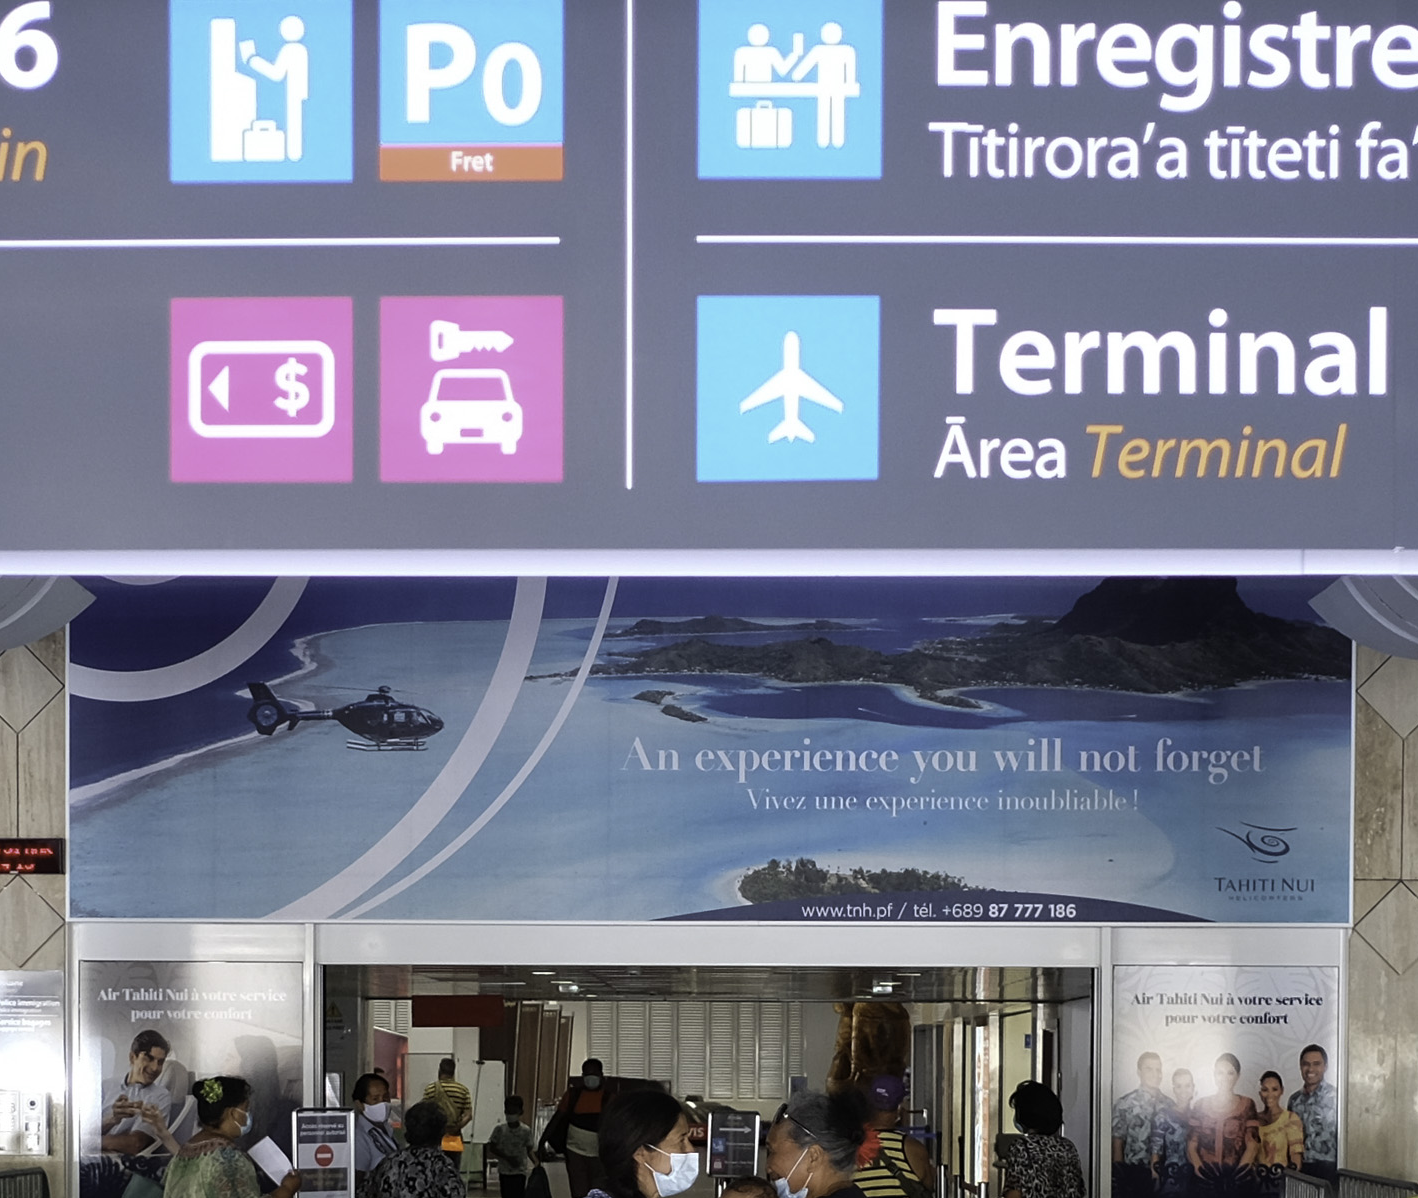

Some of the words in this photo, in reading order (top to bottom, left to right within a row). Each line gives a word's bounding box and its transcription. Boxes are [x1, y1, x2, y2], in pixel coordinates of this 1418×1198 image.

[449, 151, 495, 173] Fret
[933, 306, 1388, 397] Terminal
[933, 416, 1067, 480] Ārea
[1086, 423, 1348, 479] Terminal
[622, 736, 679, 771] An
[694, 737, 899, 784] experience
[909, 750, 977, 785] you
[992, 737, 1062, 772] will
[1078, 744, 1140, 773] not
[1154, 736, 1265, 784] forget
[747, 788, 806, 810] Vivez
[815, 796, 857, 810] une
[865, 789, 989, 818] experience
[998, 789, 1127, 811] inoubliable
[1214, 877, 1275, 892] TAHITI
[1281, 877, 1315, 893] NUI
[801, 902, 894, 920] www.tnh.pf
[913, 902, 937, 918] tél.
[942, 903, 984, 918] +689
[988, 903, 1009, 918] 87
[1014, 903, 1044, 918] 777
[1048, 903, 1077, 918] 186
[97, 987, 120, 1001] Air
[122, 987, 163, 1001] Tahiti
[166, 988, 188, 1001] Nui
[1131, 993, 1154, 1006] Air
[1156, 992, 1198, 1006] Tahiti
[1200, 993, 1224, 1006] Nui
[1238, 996, 1273, 1006] votre
[1275, 993, 1323, 1006] service
[131, 1008, 164, 1023] pour
[1165, 1013, 1198, 1026] pour
[1201, 1014, 1237, 1025] votre
[1239, 1011, 1289, 1025] confort
